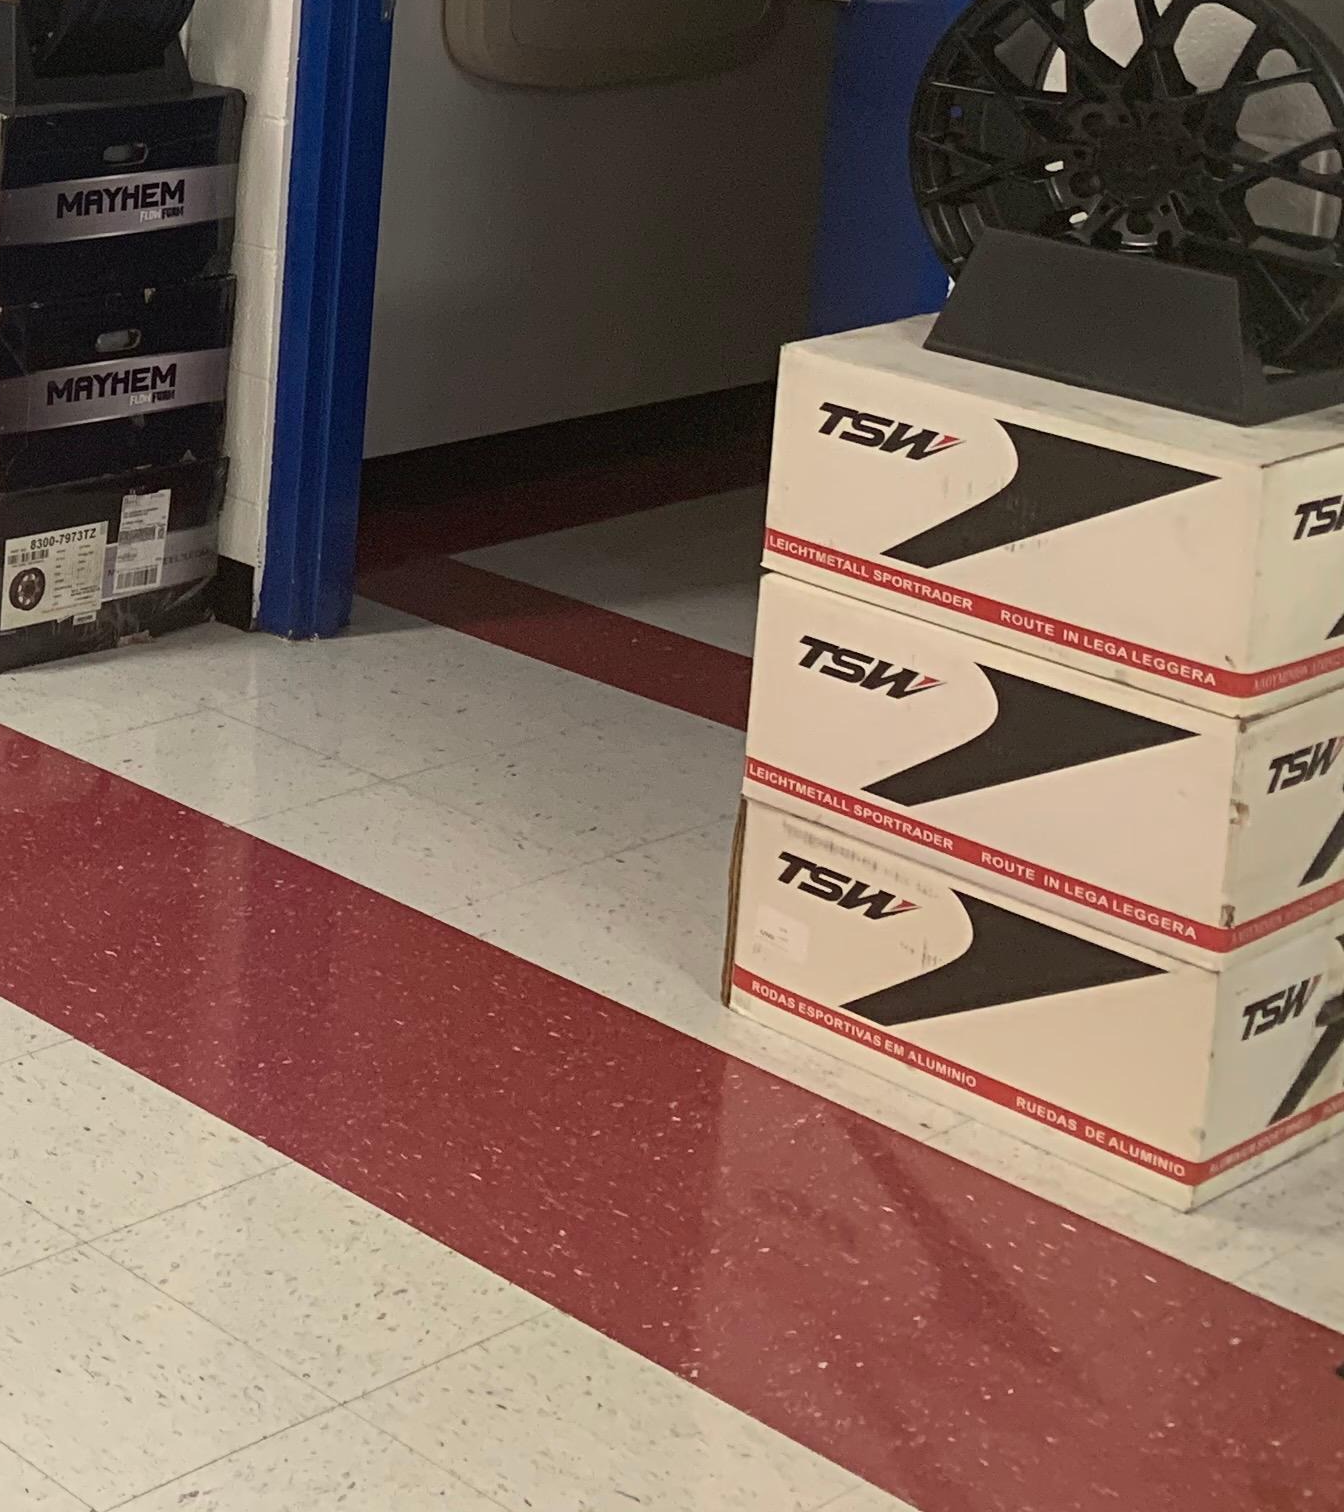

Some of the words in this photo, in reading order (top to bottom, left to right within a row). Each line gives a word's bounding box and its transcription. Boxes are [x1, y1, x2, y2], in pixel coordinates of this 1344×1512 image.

[57, 179, 185, 219] MAYHEM
[47, 362, 177, 406] MAYHEM
[818, 401, 966, 461] TSW
[30, 527, 97, 551] 8300-7973TZ
[769, 535, 870, 578] LEICHTMETALL
[873, 569, 973, 611] SPORTRADER
[798, 635, 947, 700] TSW
[1000, 609, 1055, 637] ROUTE
[1063, 629, 1079, 644] IN
[1083, 635, 1128, 660] LEGA
[1131, 650, 1217, 686] LEGGERA
[1267, 735, 1344, 794] TSW
[749, 763, 850, 812] LEICHTMETALL
[853, 804, 954, 851] SPORTRADER
[777, 851, 922, 920] TSW
[981, 851, 1035, 881] ROUTE
[1044, 874, 1060, 890] IN
[1065, 882, 1109, 908] LEGA
[1112, 899, 1197, 940] LEGGERA
[752, 980, 795, 1009] RODAS
[798, 1000, 881, 1047] ESPORTIVAS
[884, 1039, 904, 1056] EM
[907, 1050, 977, 1087] ALUMINIO
[1240, 974, 1323, 1042] TSW
[1016, 1095, 1077, 1132] RUEDAS
[1084, 1124, 1105, 1144] DE
[1108, 1136, 1185, 1177] ALUMINIO
